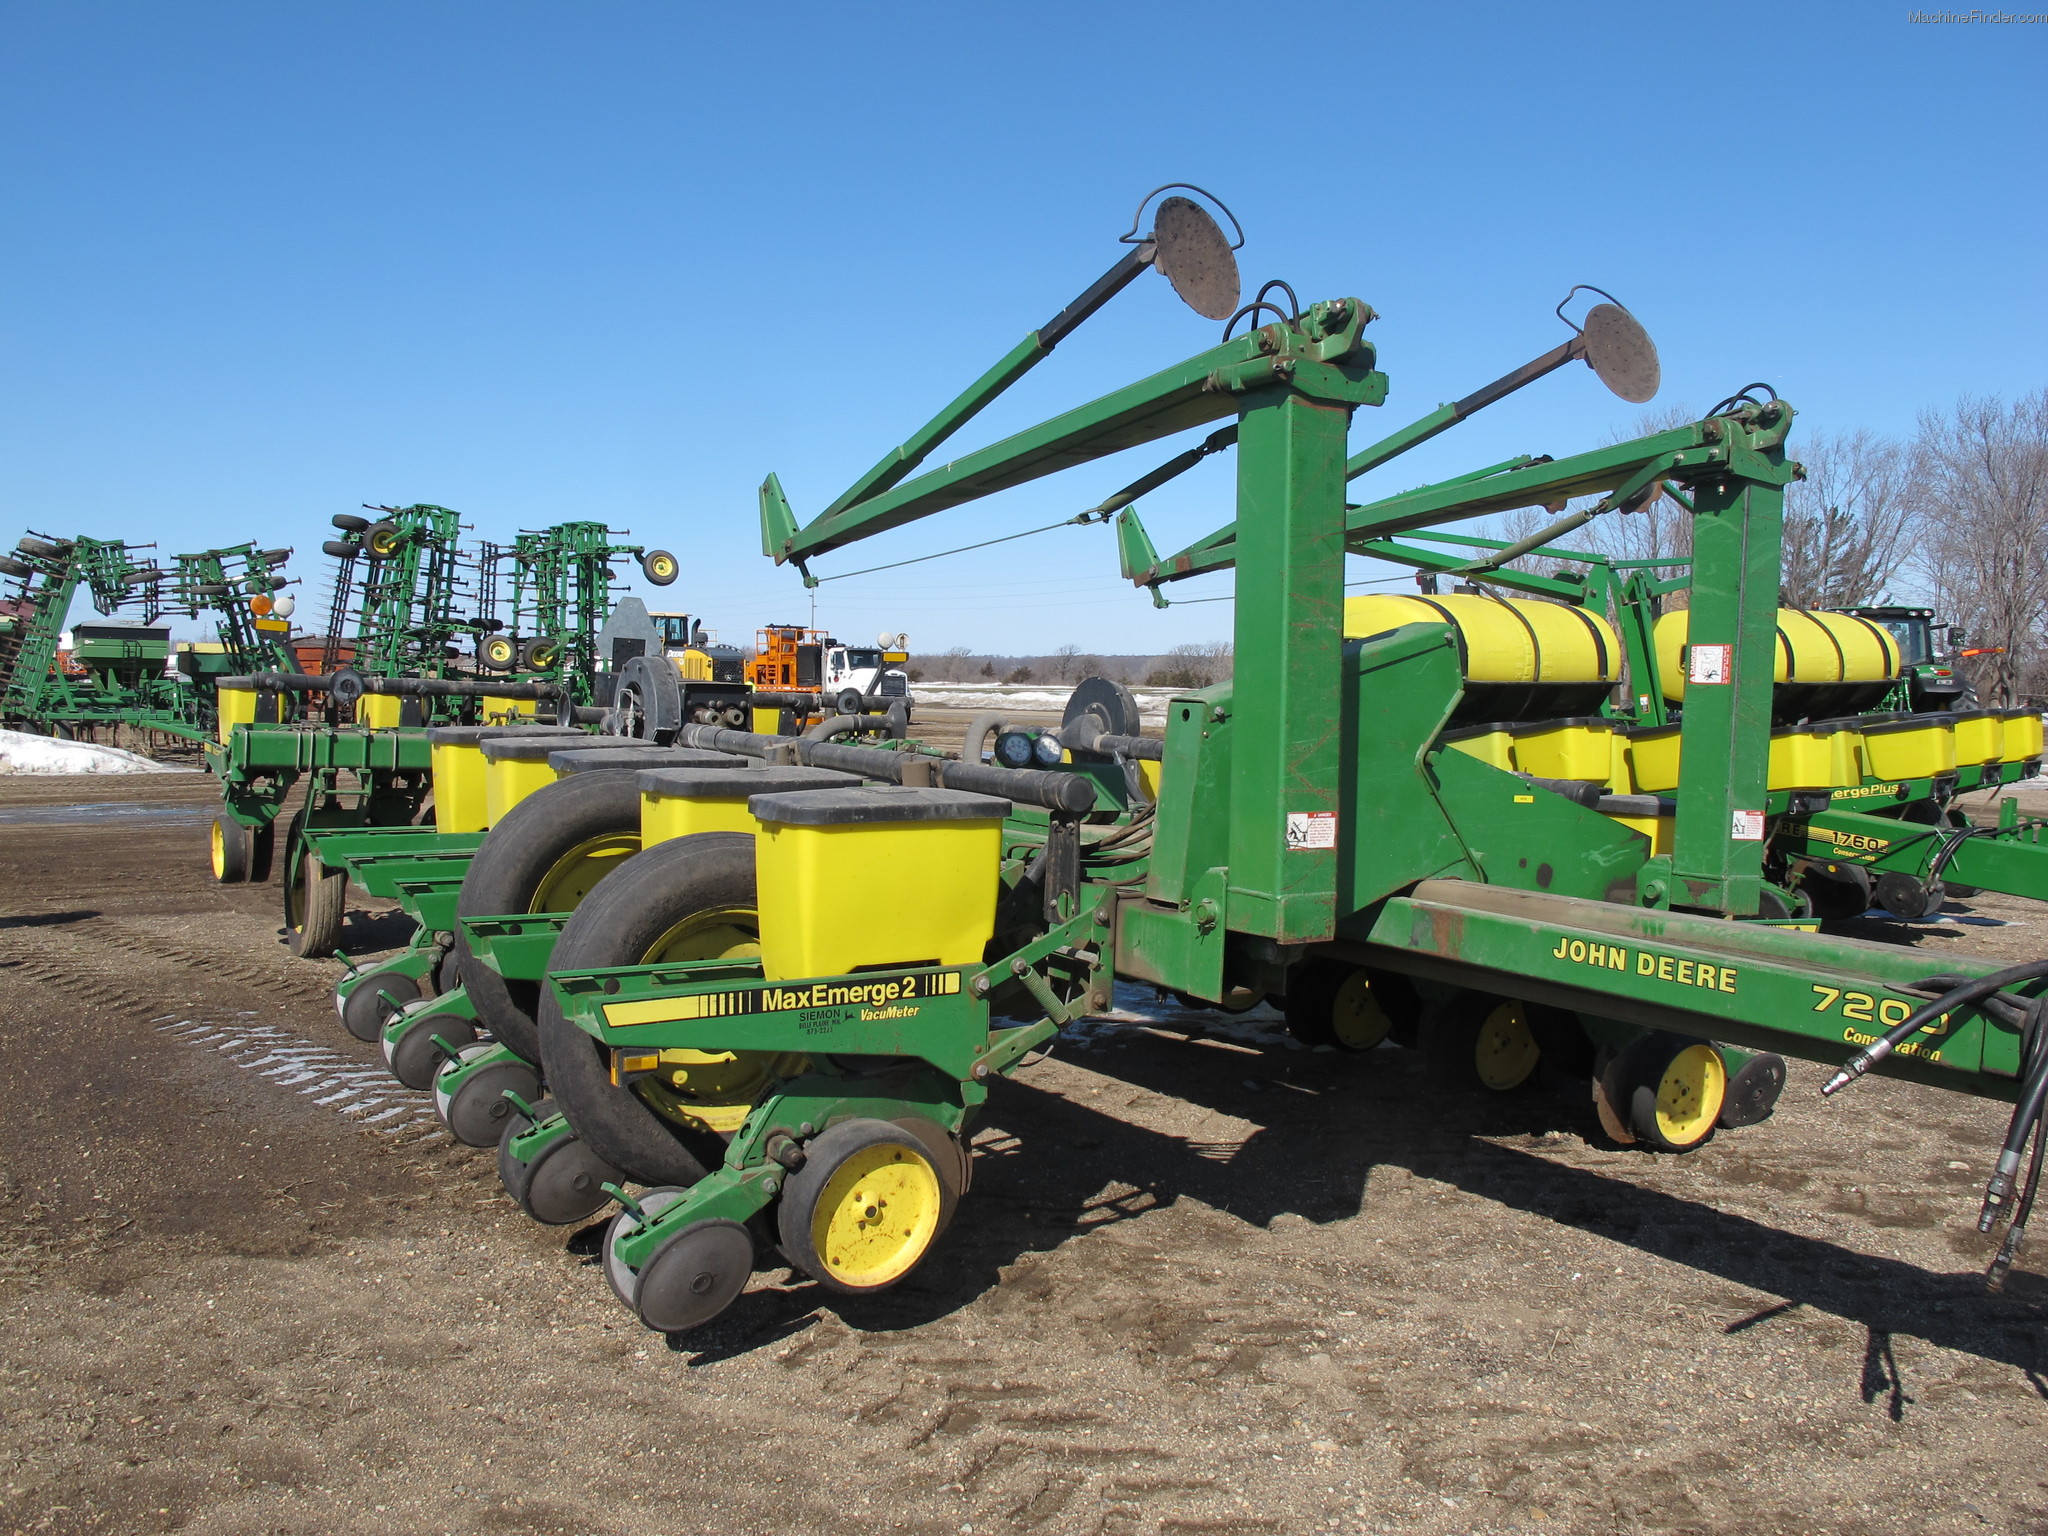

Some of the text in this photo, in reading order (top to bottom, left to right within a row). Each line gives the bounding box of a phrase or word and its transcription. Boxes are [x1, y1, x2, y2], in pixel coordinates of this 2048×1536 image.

[1832, 831, 1880, 852] 1760
[1552, 937, 1738, 995] JOHN DEERE
[799, 1009, 841, 1022] SIEMON
[860, 1005, 920, 1021] VacuMeter
[1842, 1026, 1943, 1062] Consvation
